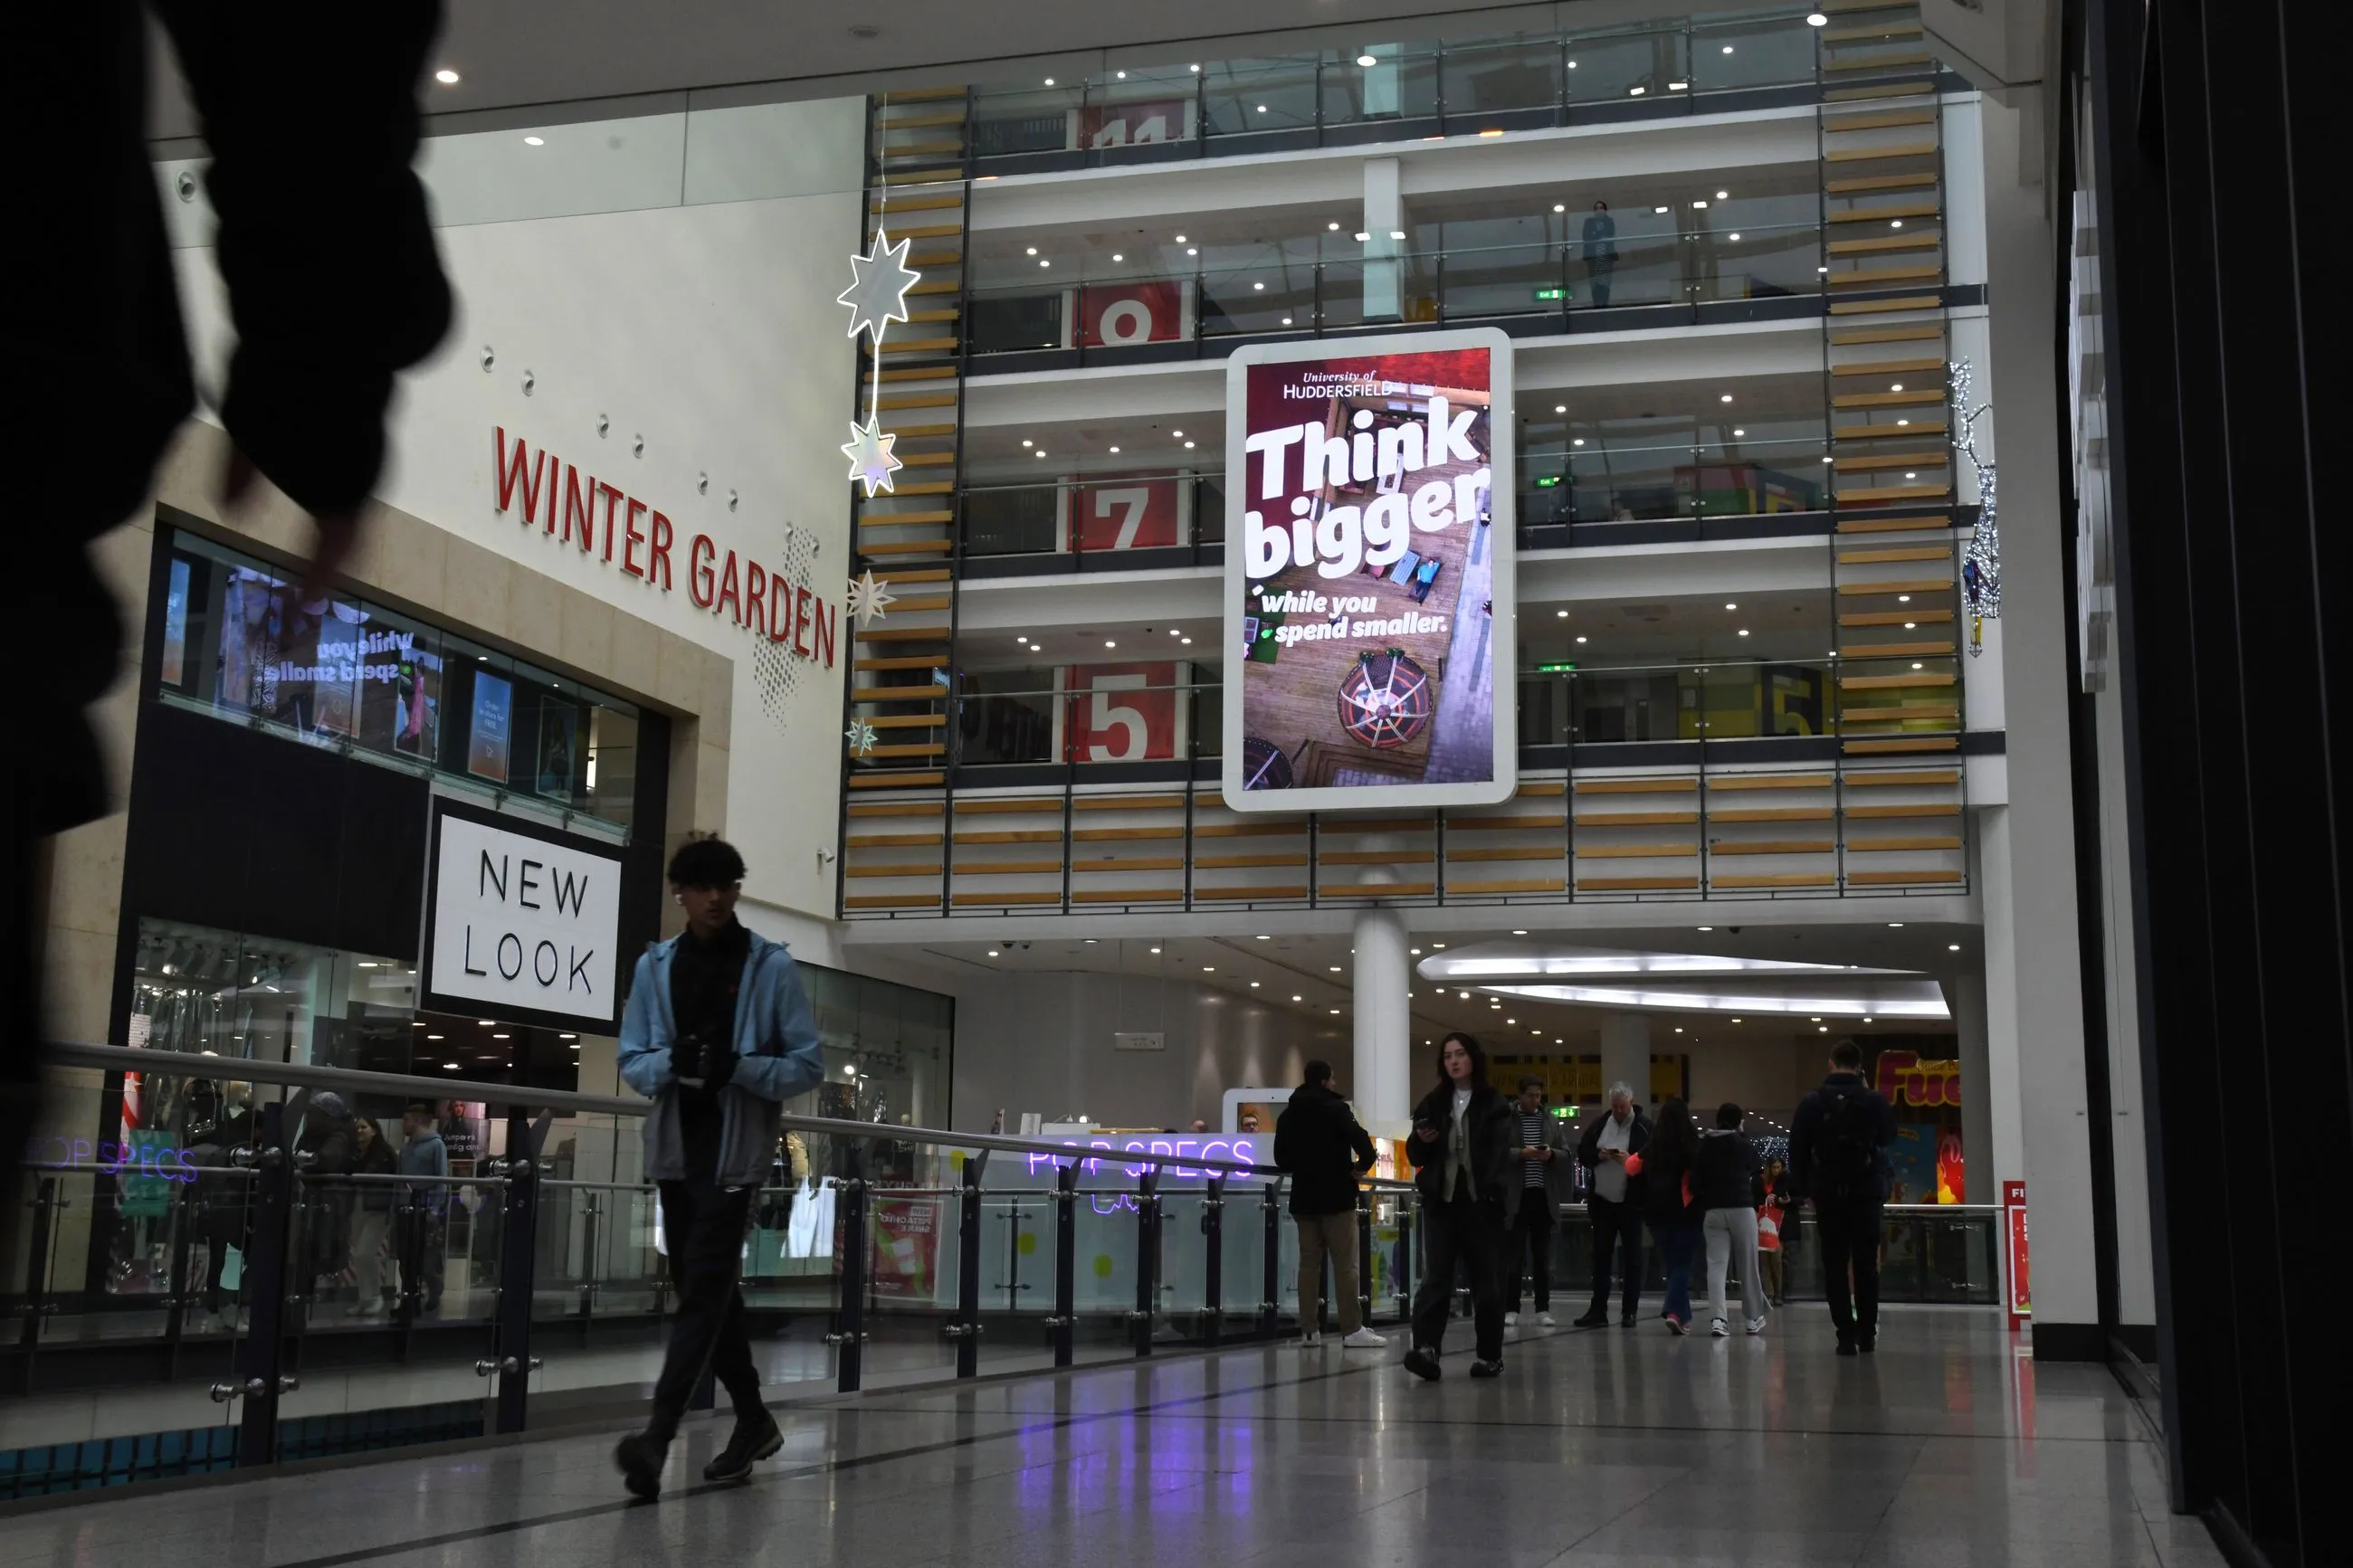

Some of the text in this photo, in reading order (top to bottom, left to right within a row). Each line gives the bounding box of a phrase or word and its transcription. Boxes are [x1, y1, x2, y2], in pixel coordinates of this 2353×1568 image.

[1283, 380, 1392, 400] HUDDERSFIELD
[1303, 369, 1377, 384] University of
[1245, 396, 1481, 501] Think
[496, 426, 835, 669] WINTER GARDEN
[1095, 488, 1150, 551] 7
[1245, 466, 1491, 580] bigger
[1262, 590, 1378, 620] while you
[1274, 610, 1449, 649] spend smaller.
[1091, 674, 1148, 762] 5
[479, 849, 589, 919] NEW
[463, 923, 595, 995] LOOK
[1126, 1140, 1254, 1177] SPECS
